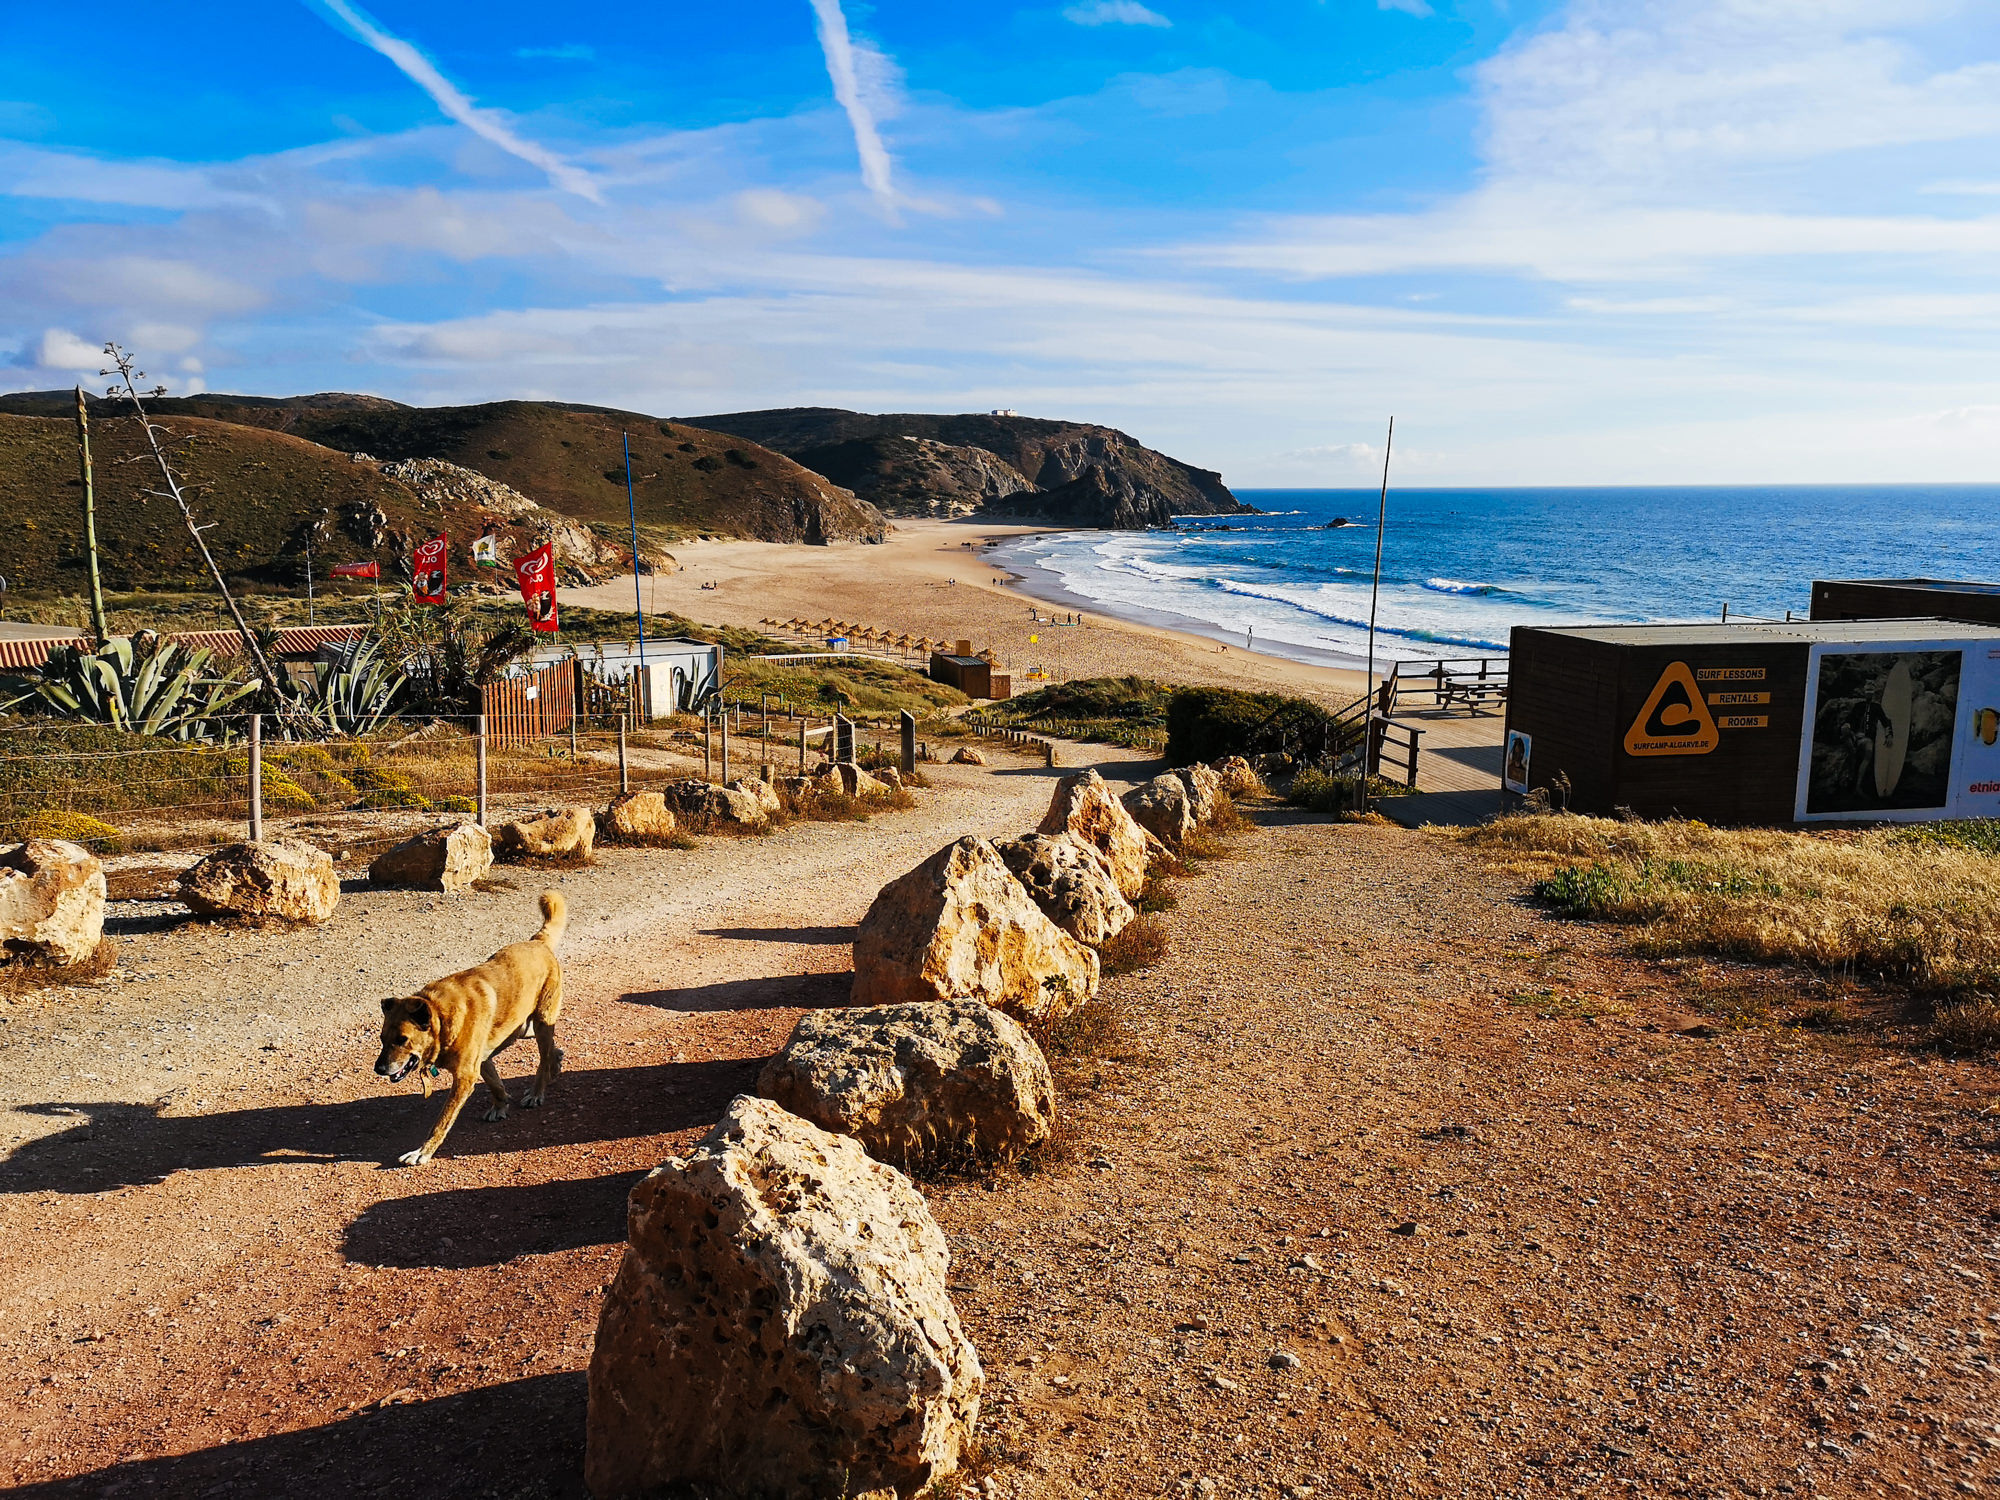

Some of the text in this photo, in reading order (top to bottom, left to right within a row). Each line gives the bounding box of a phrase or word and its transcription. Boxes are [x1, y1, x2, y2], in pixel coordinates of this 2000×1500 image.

[1698, 669, 1763, 680] SURF LESSONS
[1719, 694, 1759, 703] RENTALS
[1727, 717, 1759, 727] ROOMS
[1633, 741, 1709, 750] SURFCAMP-ALGARVE.DE
[1969, 780, 2000, 793] etnia
